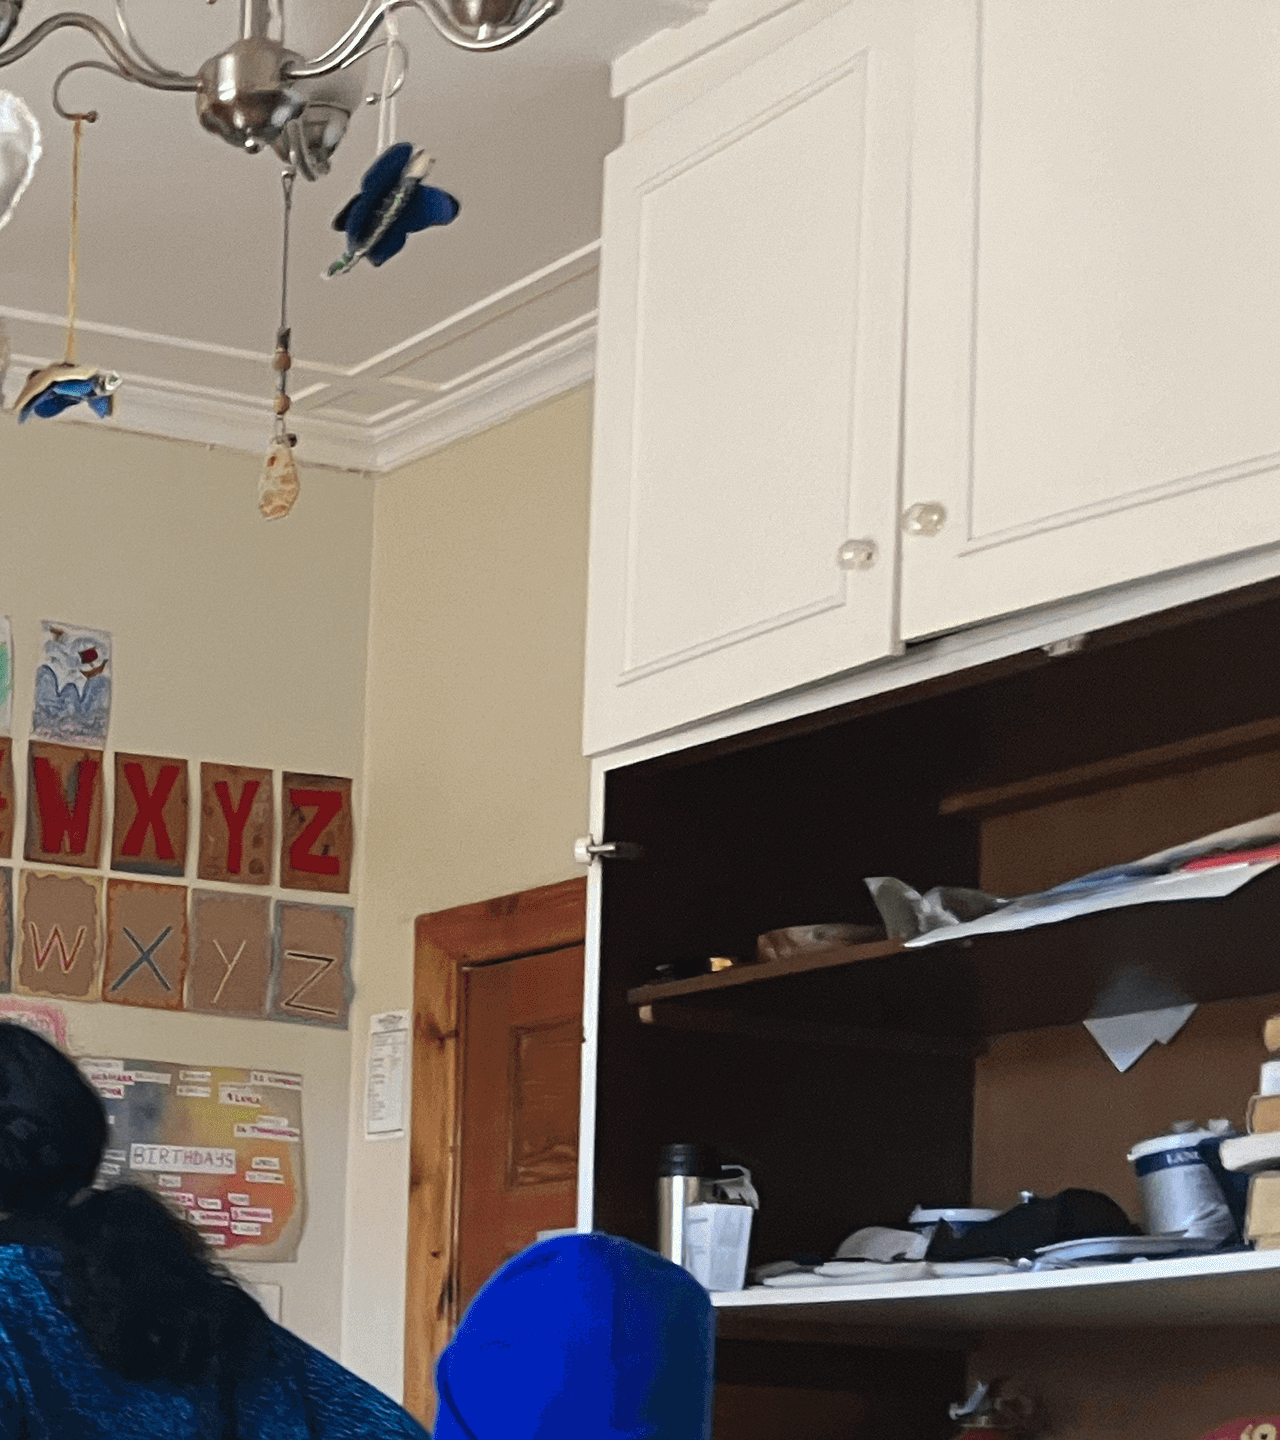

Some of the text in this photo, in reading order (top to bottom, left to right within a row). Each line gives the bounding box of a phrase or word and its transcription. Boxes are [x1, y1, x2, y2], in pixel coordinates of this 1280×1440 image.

[34, 756, 99, 854] W
[121, 763, 179, 859] X
[214, 780, 260, 874] Y
[288, 789, 342, 875] Z
[133, 1147, 234, 1168] BIRTHDAYS
